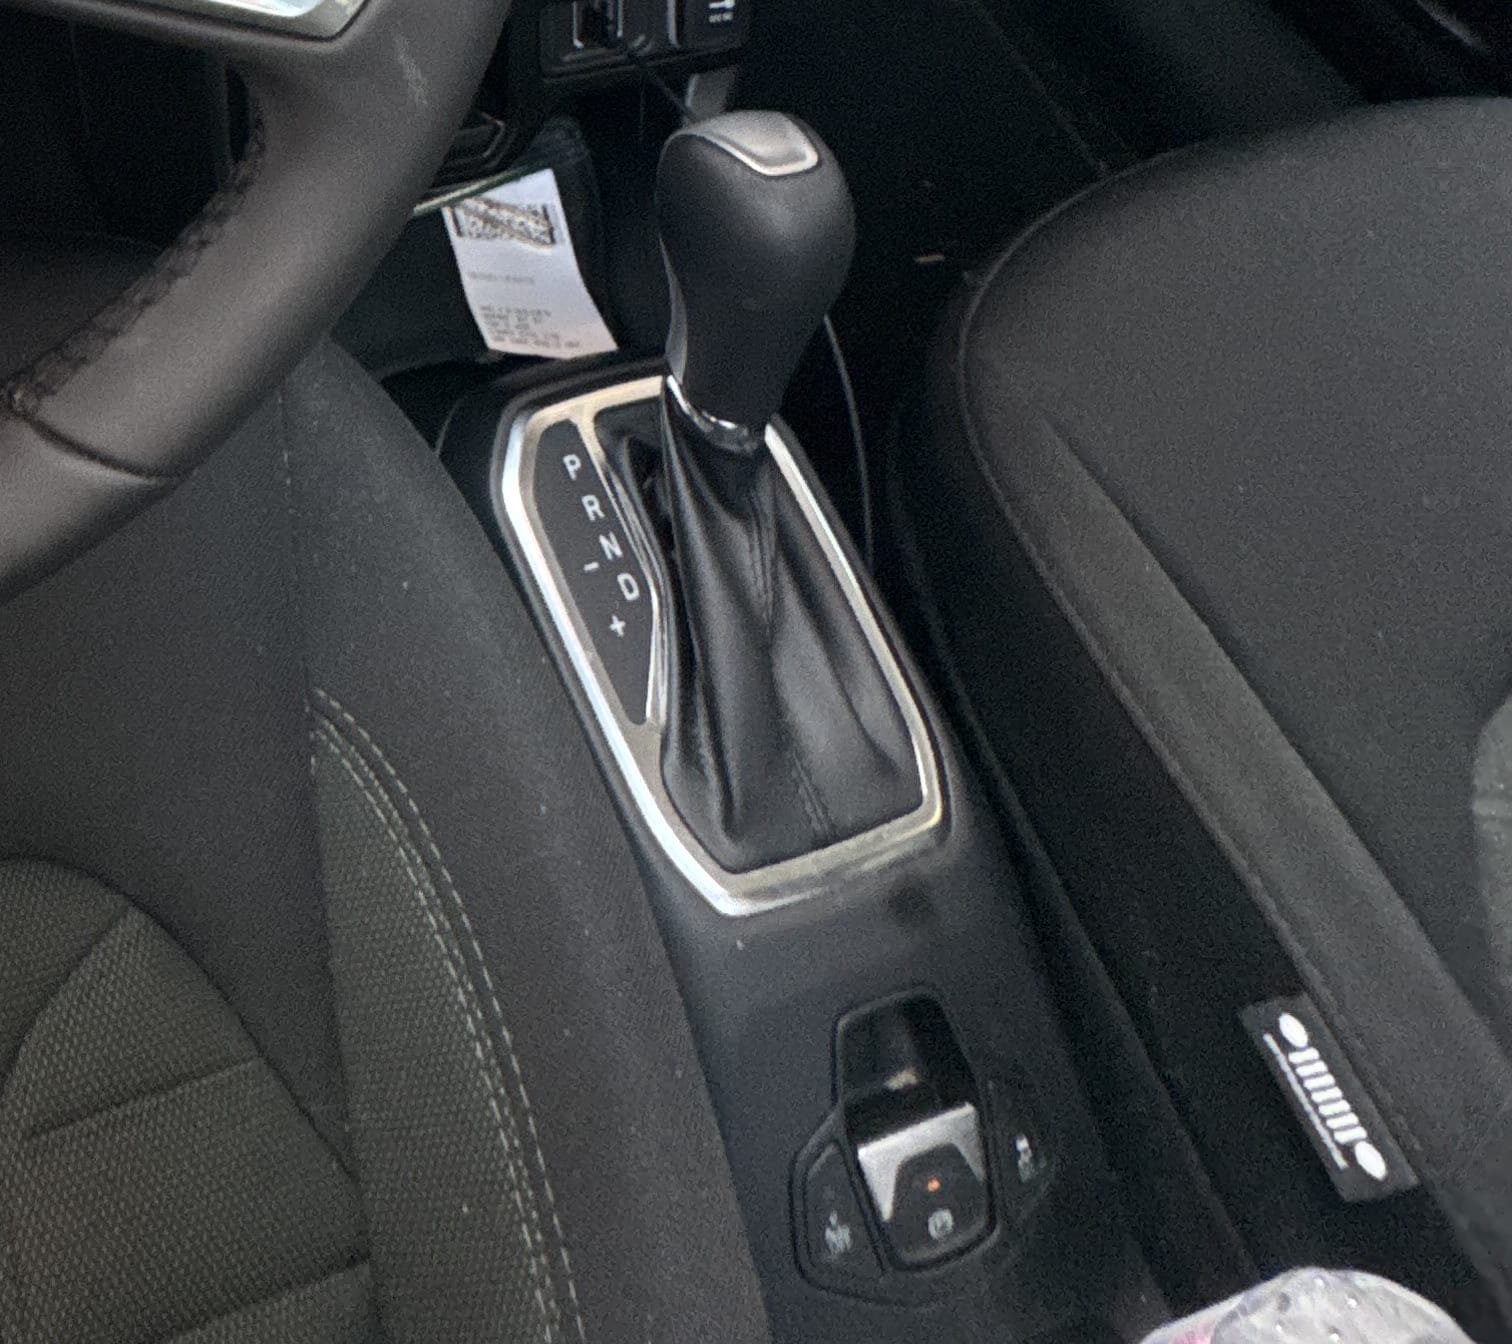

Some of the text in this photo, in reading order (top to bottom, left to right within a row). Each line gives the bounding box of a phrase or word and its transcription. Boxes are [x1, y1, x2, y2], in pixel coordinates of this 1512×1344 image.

[563, 454, 641, 601] P R N D
